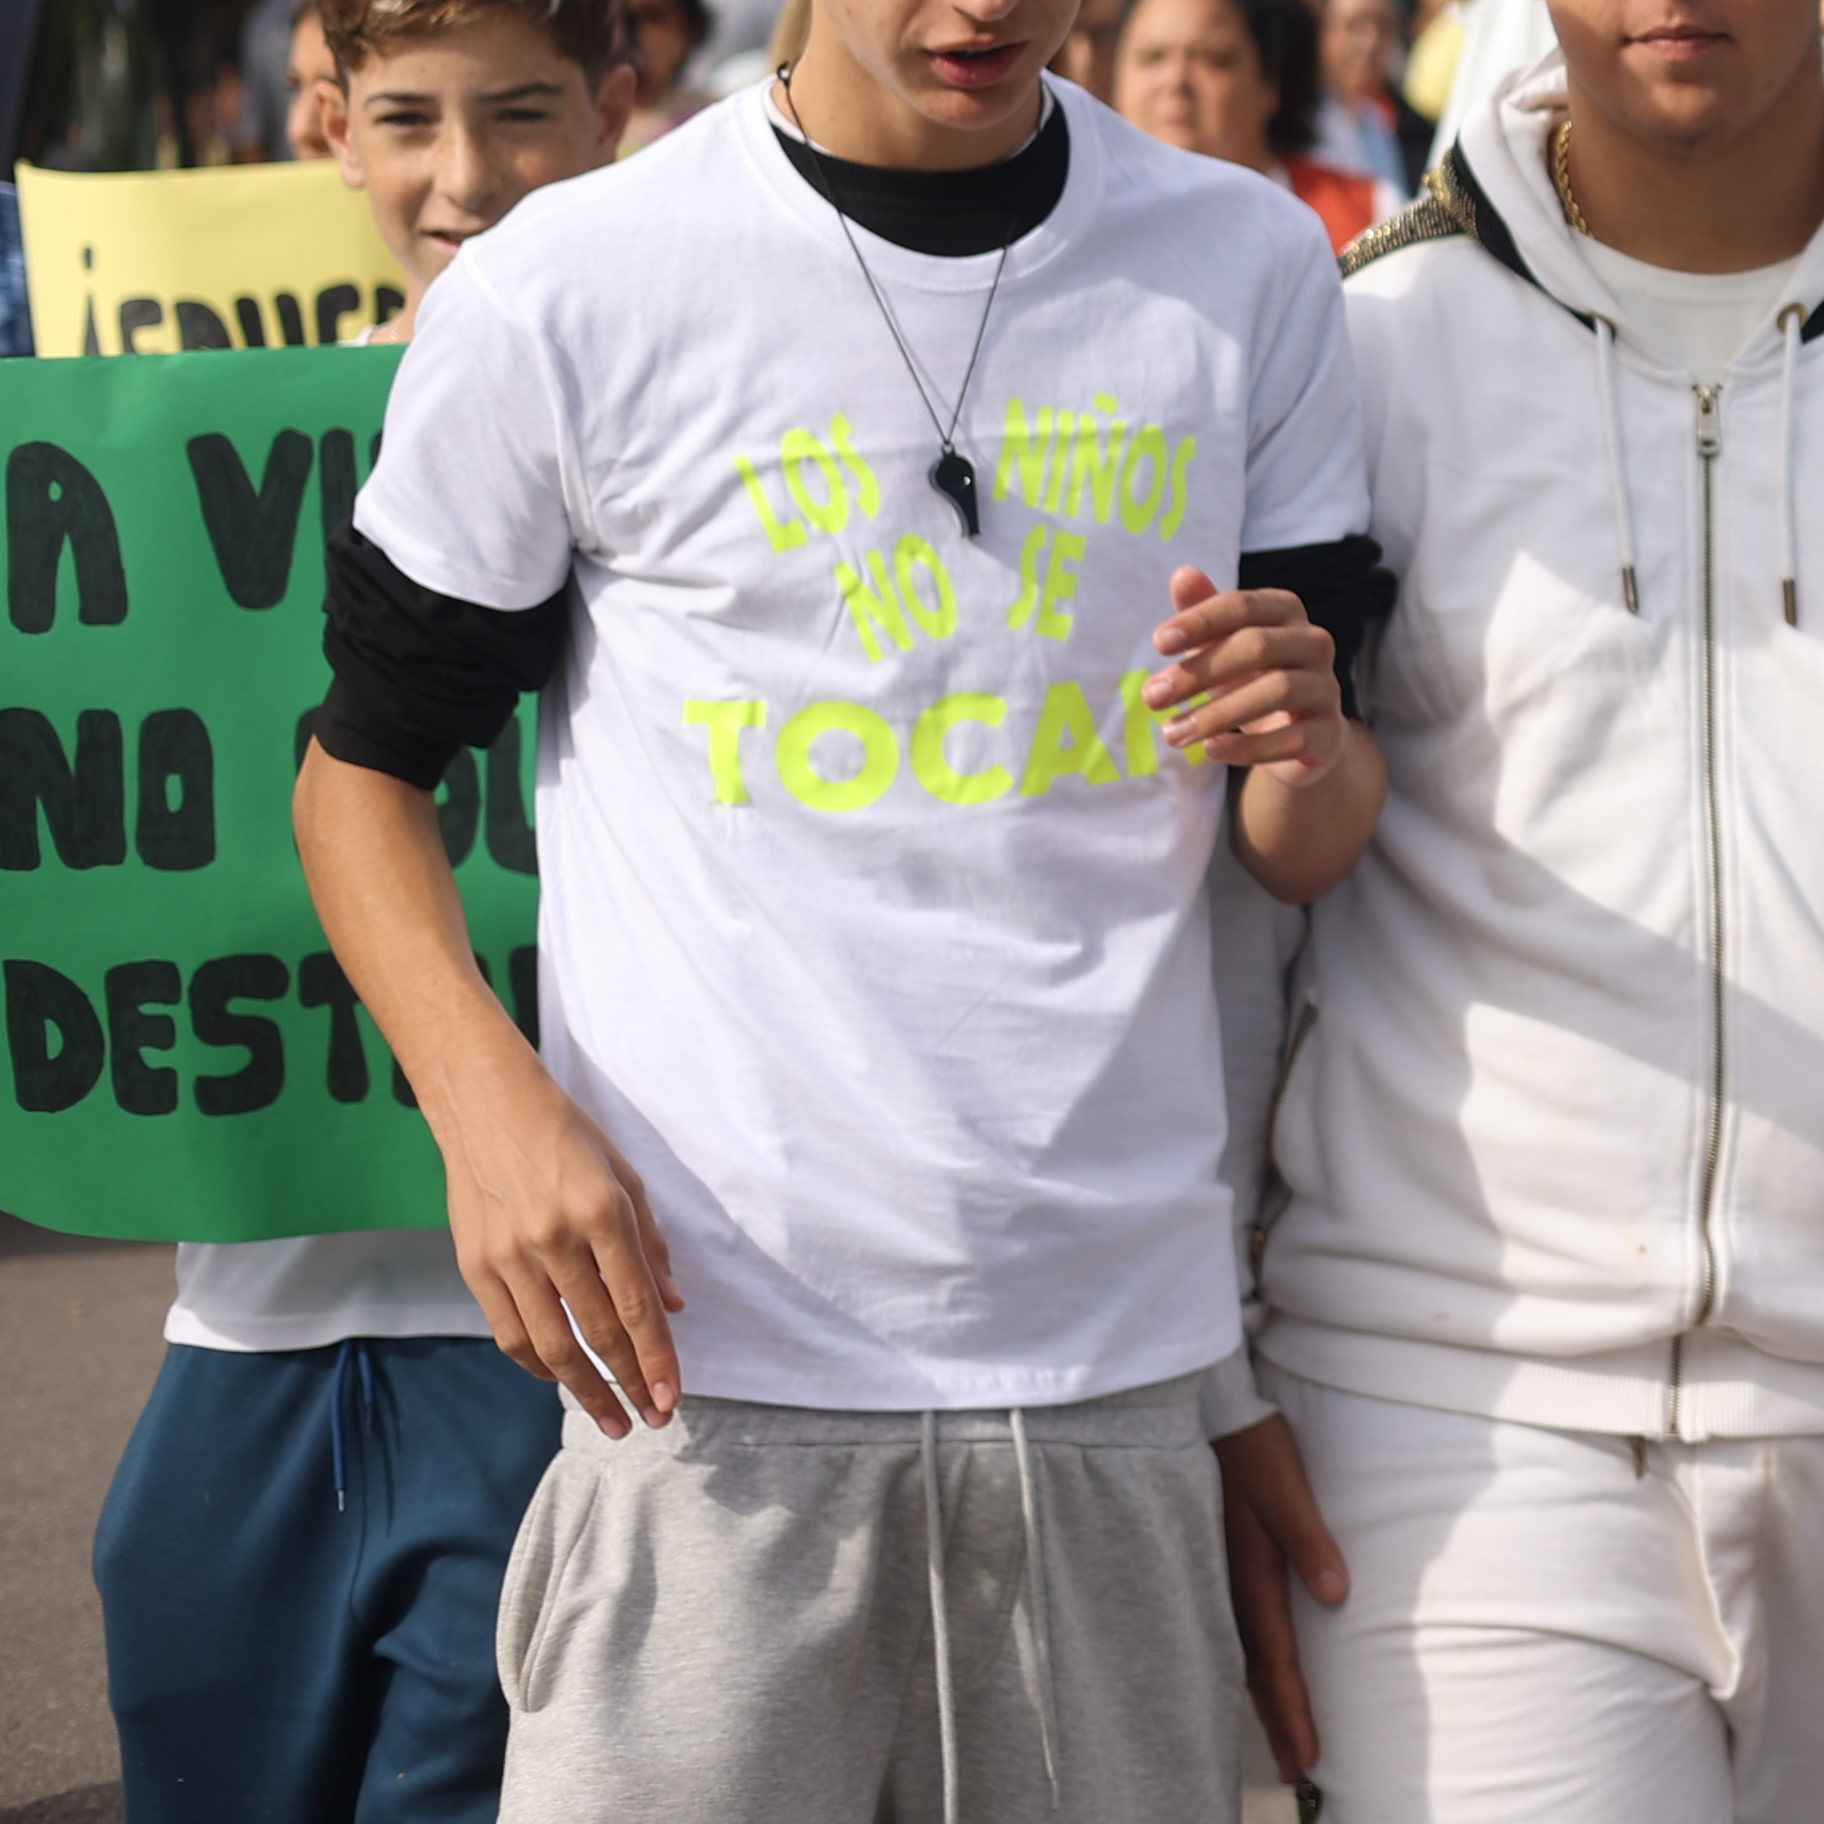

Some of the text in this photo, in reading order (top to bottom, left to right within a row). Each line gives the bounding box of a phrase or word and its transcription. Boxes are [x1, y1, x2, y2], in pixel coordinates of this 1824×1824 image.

[735, 392, 1196, 553] LOS NIÑOS
[834, 522, 1087, 662] NO SE
[0, 706, 217, 873] NO
